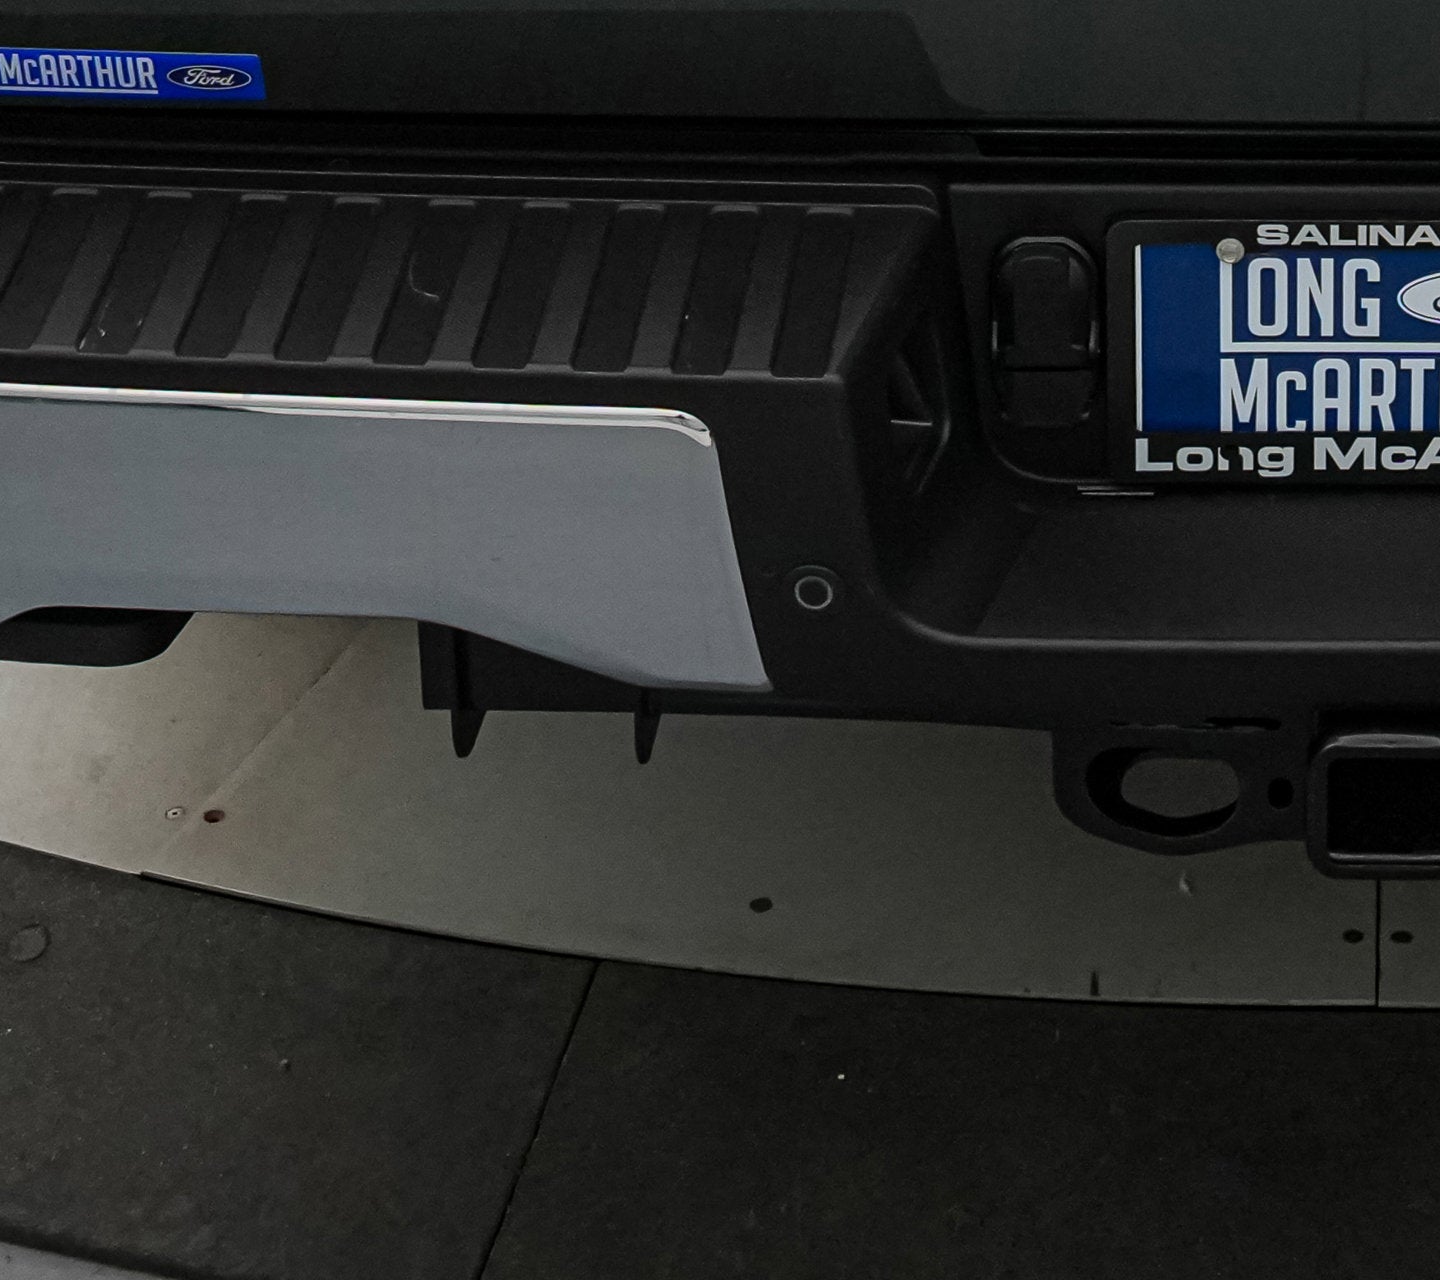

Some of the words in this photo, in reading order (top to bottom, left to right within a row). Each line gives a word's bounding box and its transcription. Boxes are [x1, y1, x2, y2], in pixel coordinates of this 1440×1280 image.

[183, 65, 235, 86] Ford
[1219, 255, 1380, 338] LONG
[1135, 437, 1295, 477] Long
